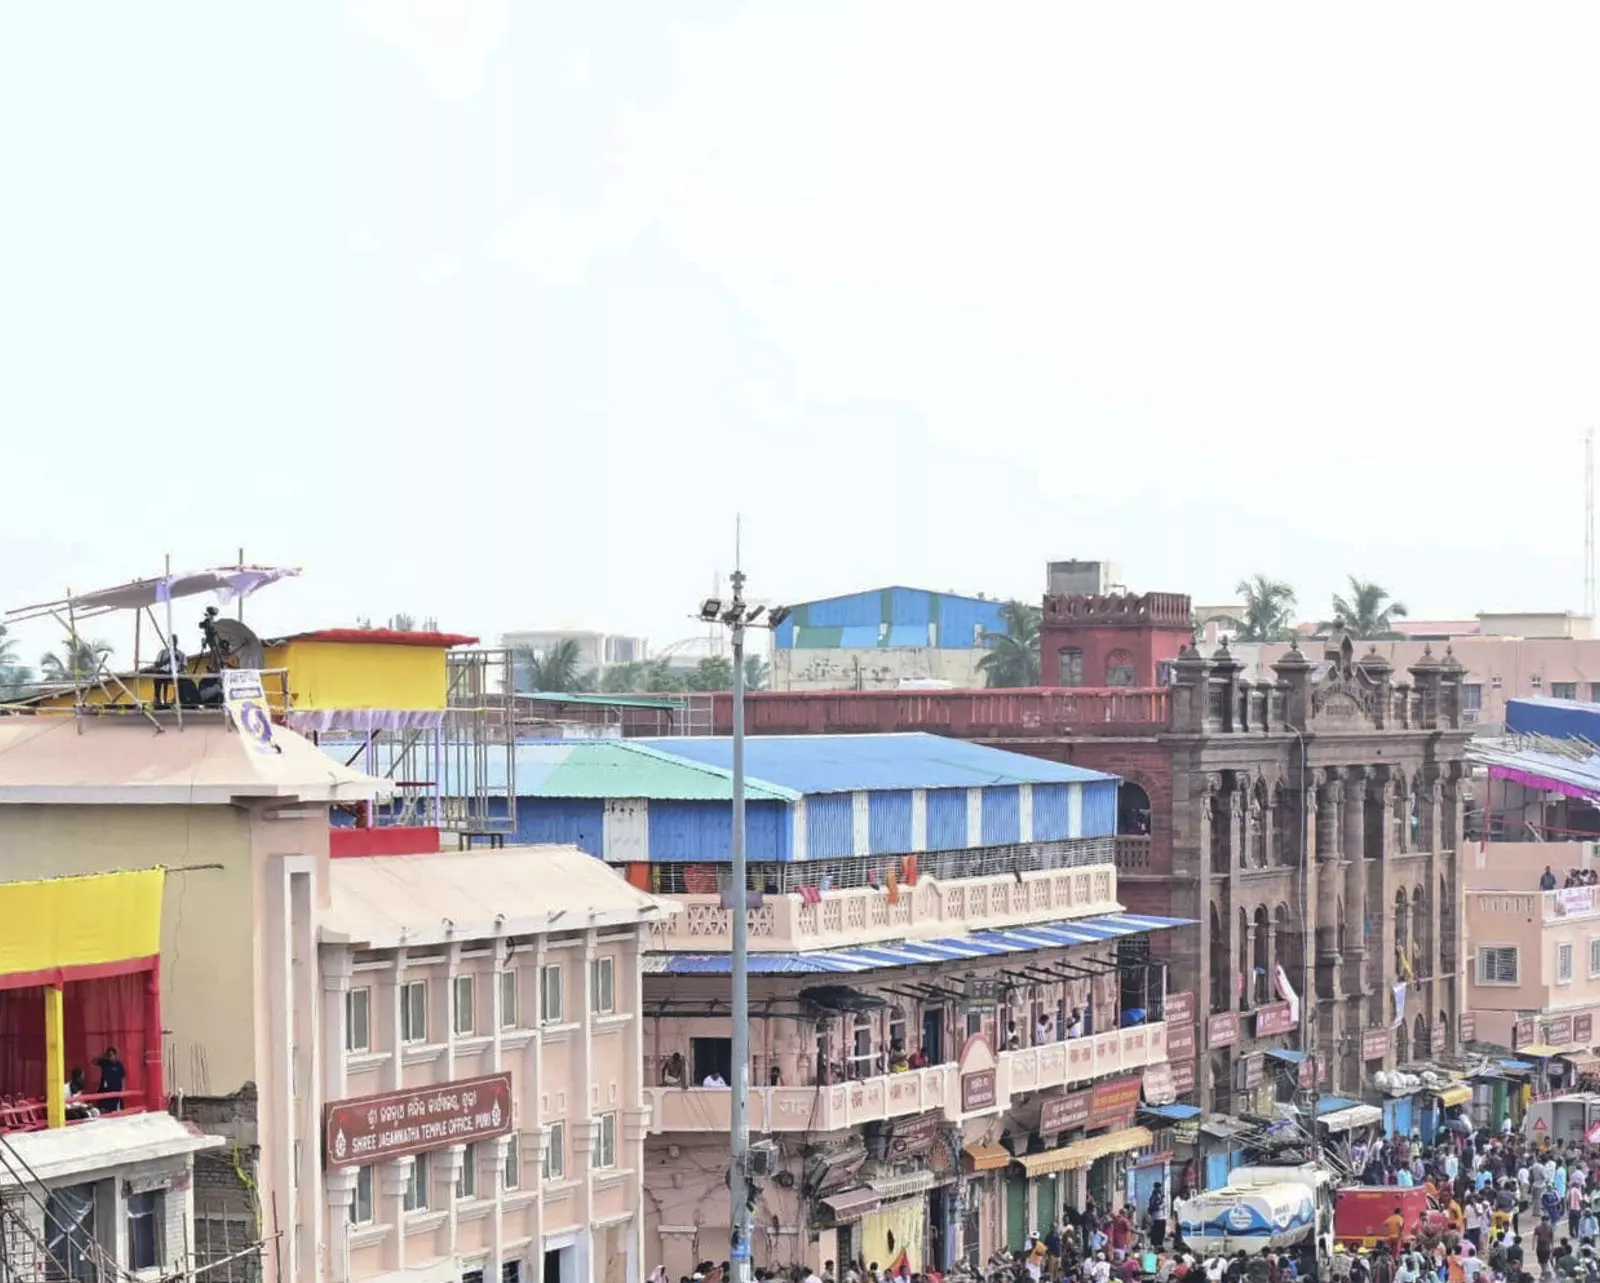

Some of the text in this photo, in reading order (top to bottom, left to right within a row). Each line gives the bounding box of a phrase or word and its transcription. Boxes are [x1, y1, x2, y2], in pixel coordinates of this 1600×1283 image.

[352, 1135, 377, 1153] SHREE
[378, 1126, 420, 1148] JAGANNATHA
[421, 1120, 448, 1138] TEMPLE
[475, 1112, 492, 1129] PURI
